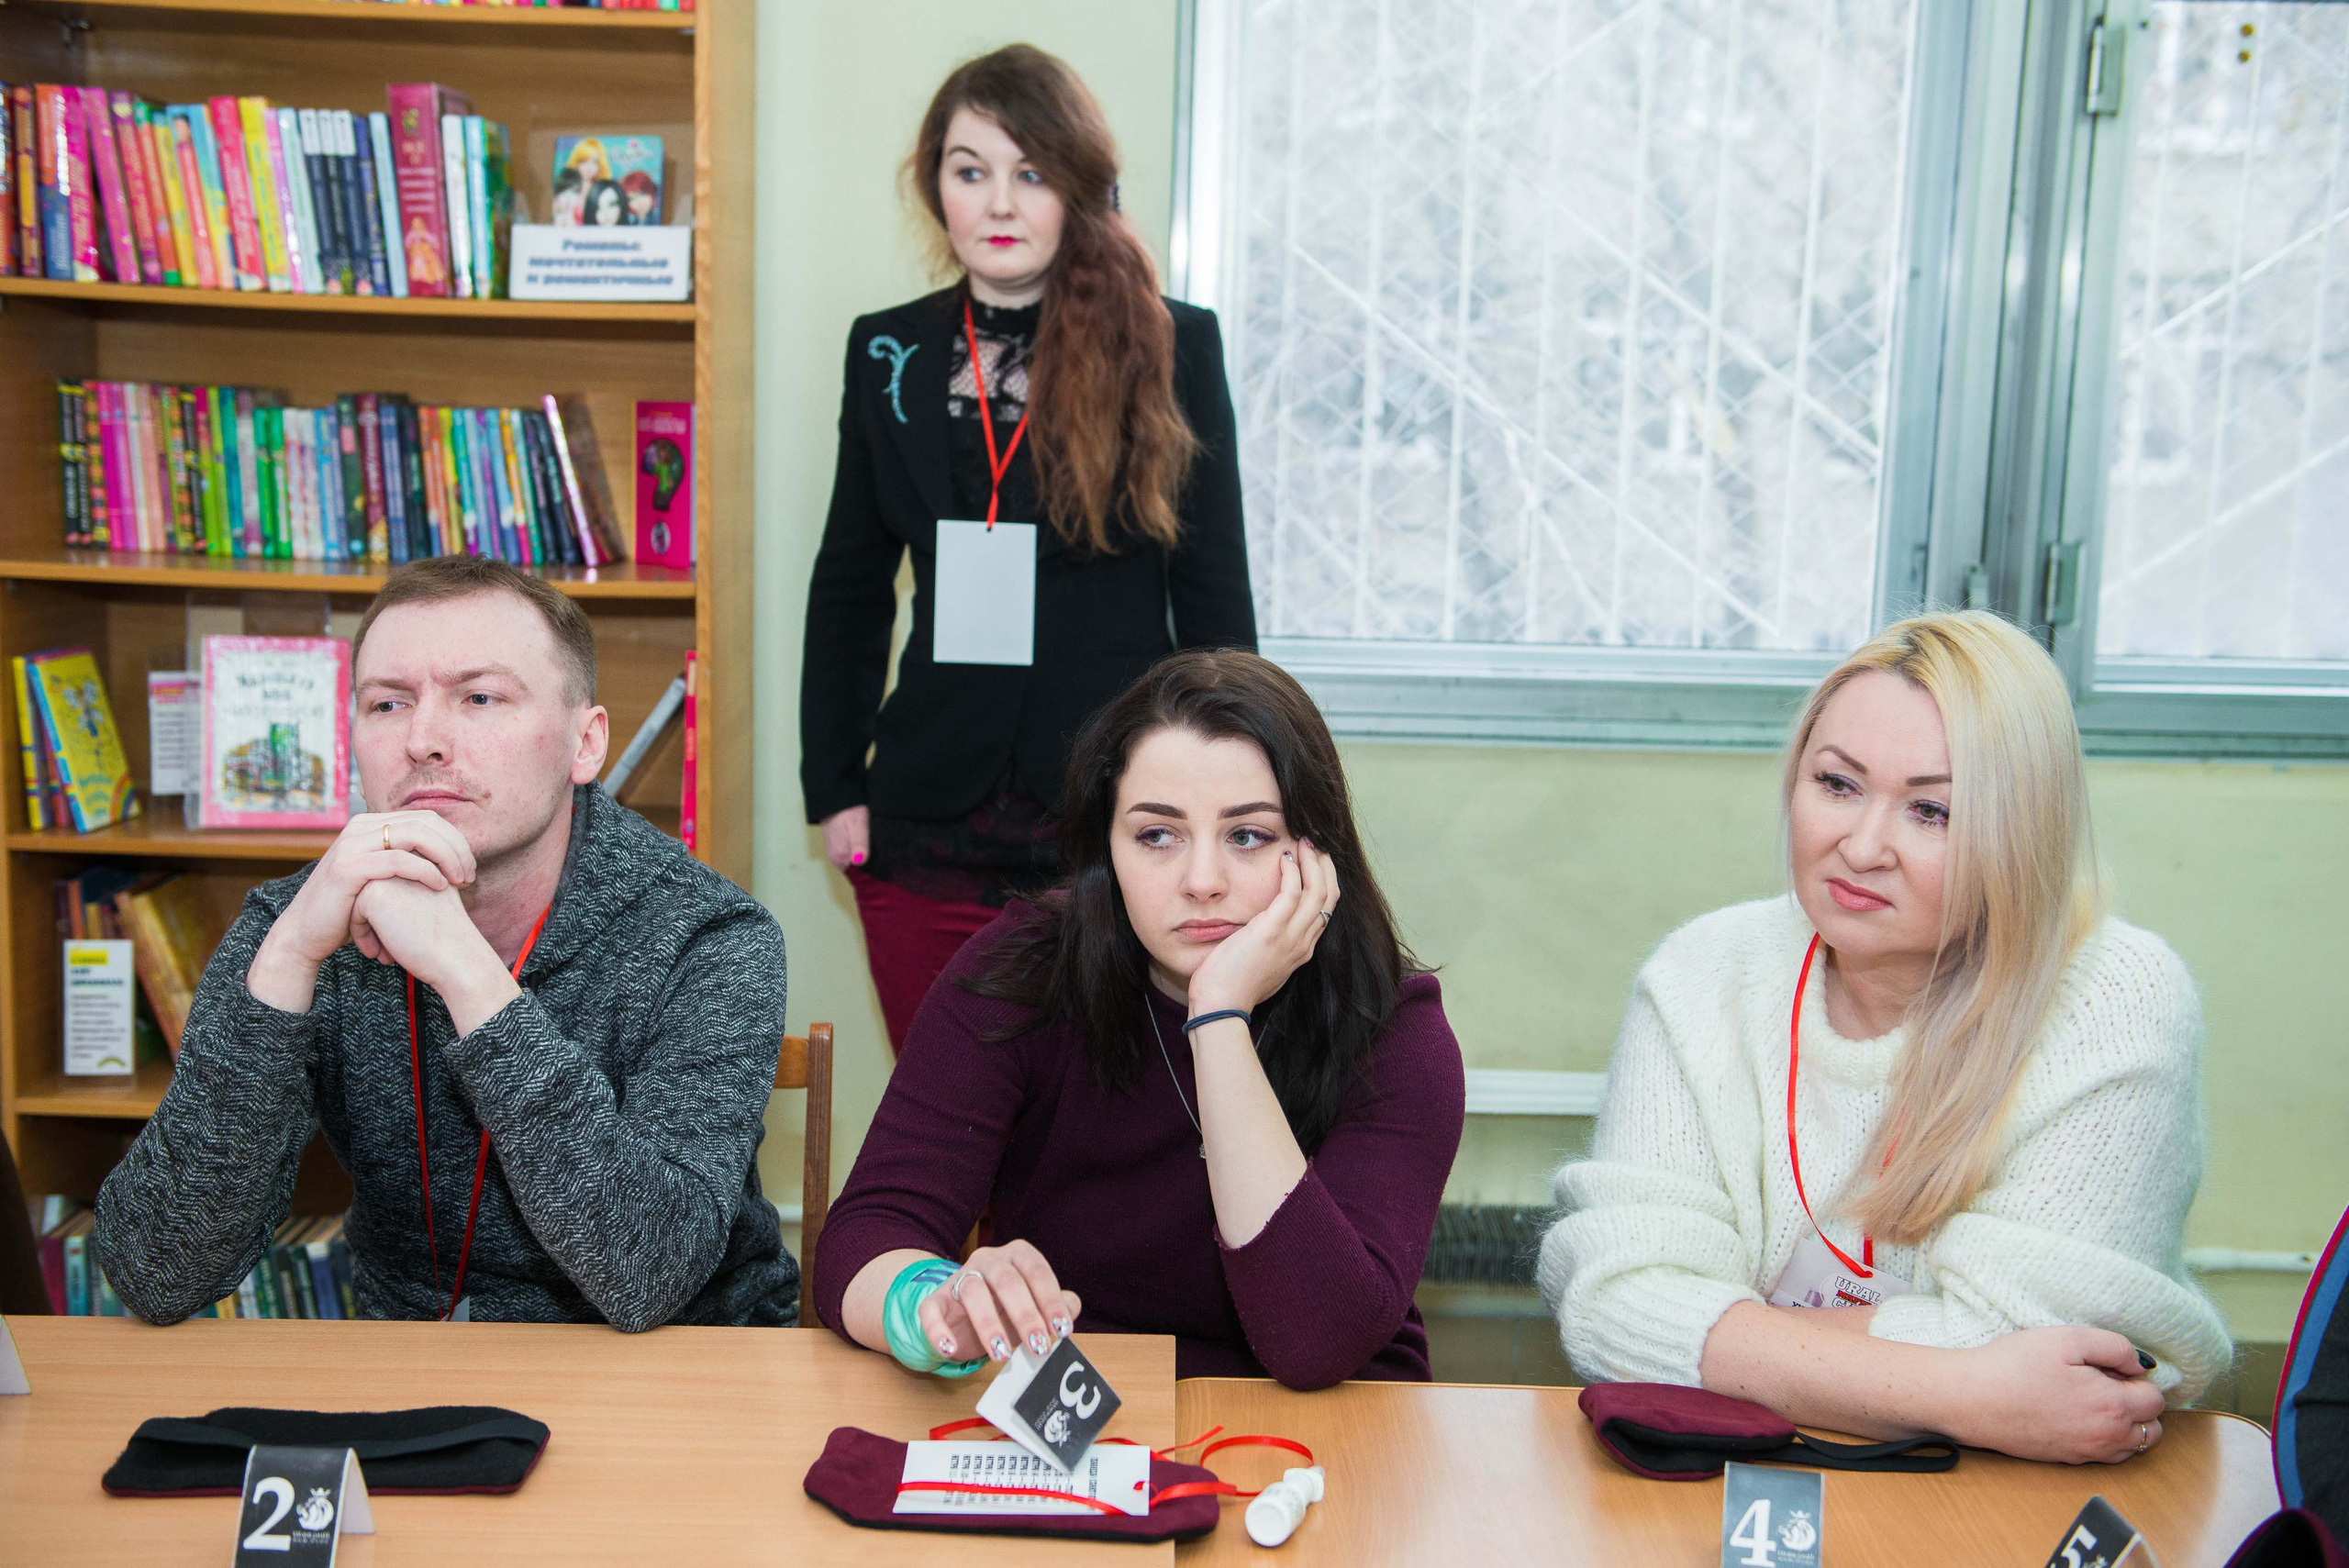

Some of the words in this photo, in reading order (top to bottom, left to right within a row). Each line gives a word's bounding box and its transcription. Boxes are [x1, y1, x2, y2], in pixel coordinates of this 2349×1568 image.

[1834, 1275, 1882, 1304] URAL
[1059, 1360, 1102, 1420] 3
[242, 1475, 295, 1551] 2
[1729, 1498, 1777, 1568] 4
